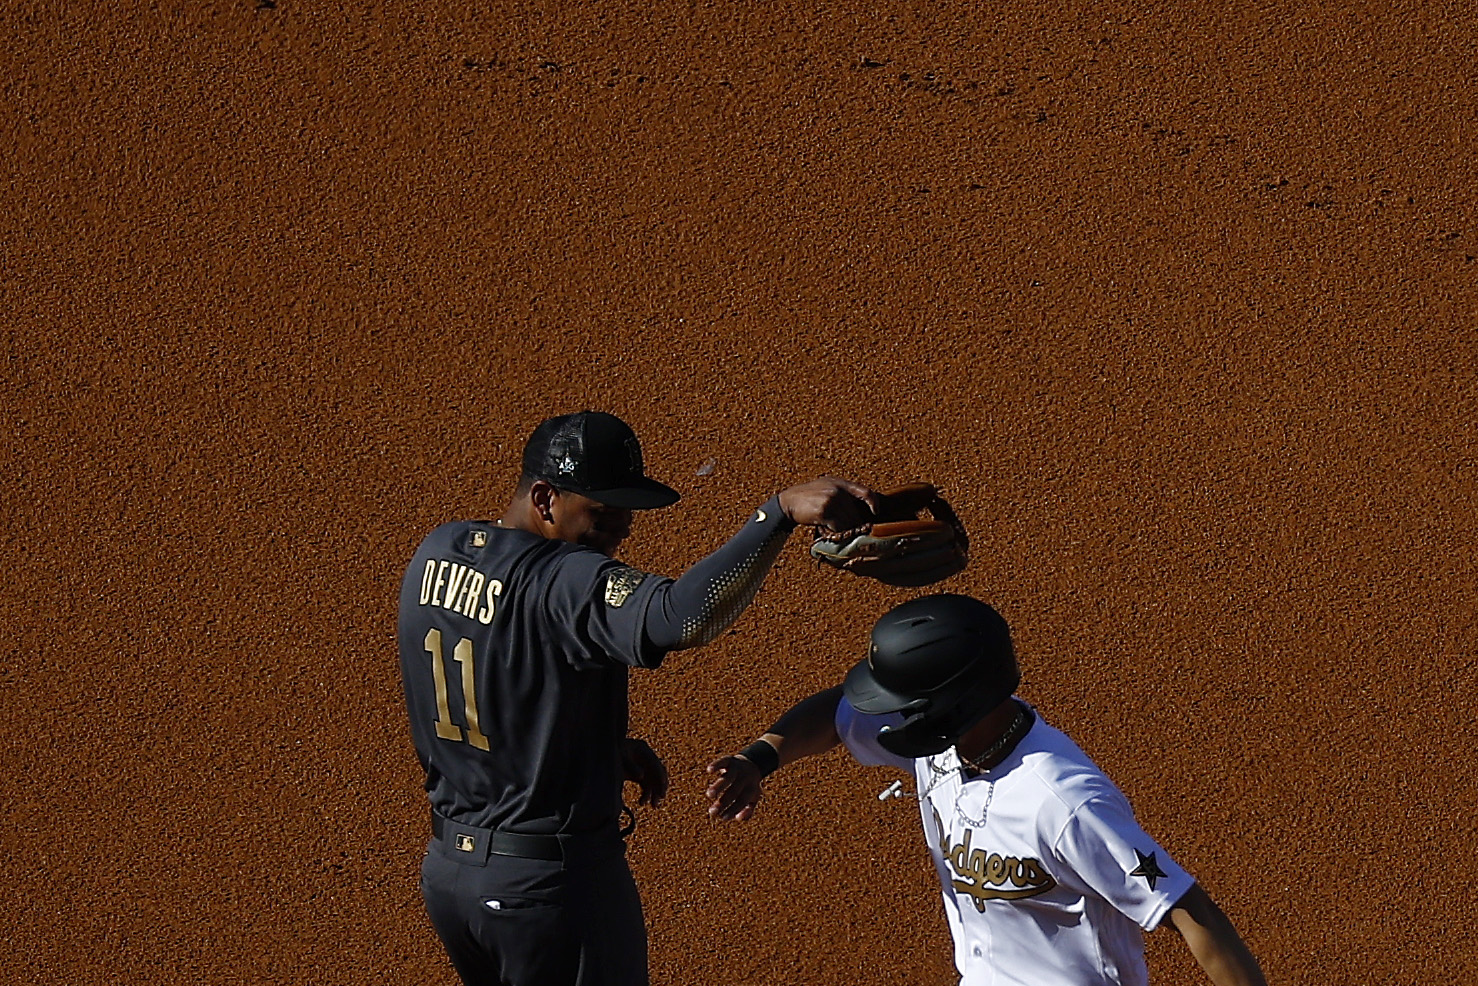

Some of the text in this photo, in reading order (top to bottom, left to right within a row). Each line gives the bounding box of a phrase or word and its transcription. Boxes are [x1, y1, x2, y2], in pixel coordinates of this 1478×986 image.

[419, 559, 503, 625] DEVERS
[424, 627, 490, 752] 11
[932, 802, 1057, 913] dgers
